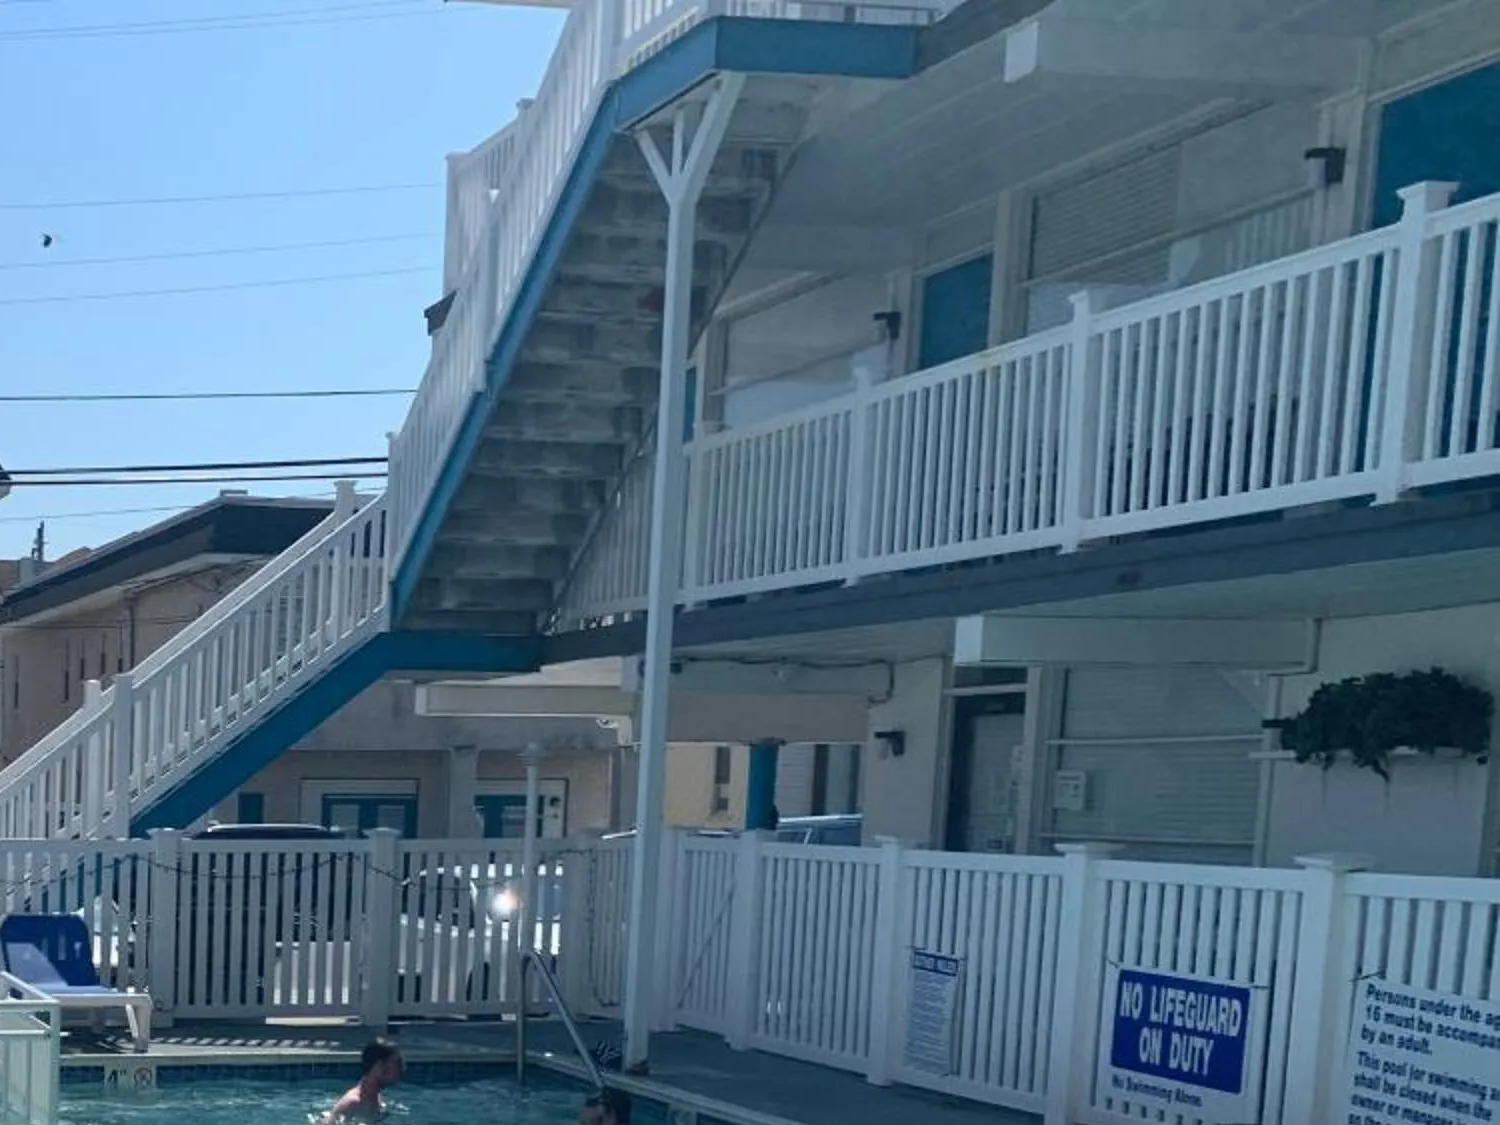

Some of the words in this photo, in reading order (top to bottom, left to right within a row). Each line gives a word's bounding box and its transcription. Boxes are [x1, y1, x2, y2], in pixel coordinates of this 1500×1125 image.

[1120, 980, 1143, 1020] NO
[1150, 985, 1242, 1037] LIFEGUARD
[1366, 983, 1416, 1009] Persons
[1419, 999, 1457, 1017] under
[1460, 1001, 1481, 1023] the
[1366, 1004, 1381, 1022] 16
[1384, 1012, 1415, 1031] must
[1417, 1015, 1433, 1034] be
[1139, 1026, 1163, 1066] ON
[1169, 1031, 1215, 1077] DUTY
[1361, 1023, 1376, 1045] by
[1378, 1031, 1395, 1046] an
[1396, 1034, 1433, 1056] adult.
[1357, 1050, 1380, 1071] This
[1382, 1060, 1408, 1077] pool
[1428, 1072, 1487, 1101] swimming
[1399, 1084, 1438, 1107] closed
[1439, 1095, 1471, 1115] when
